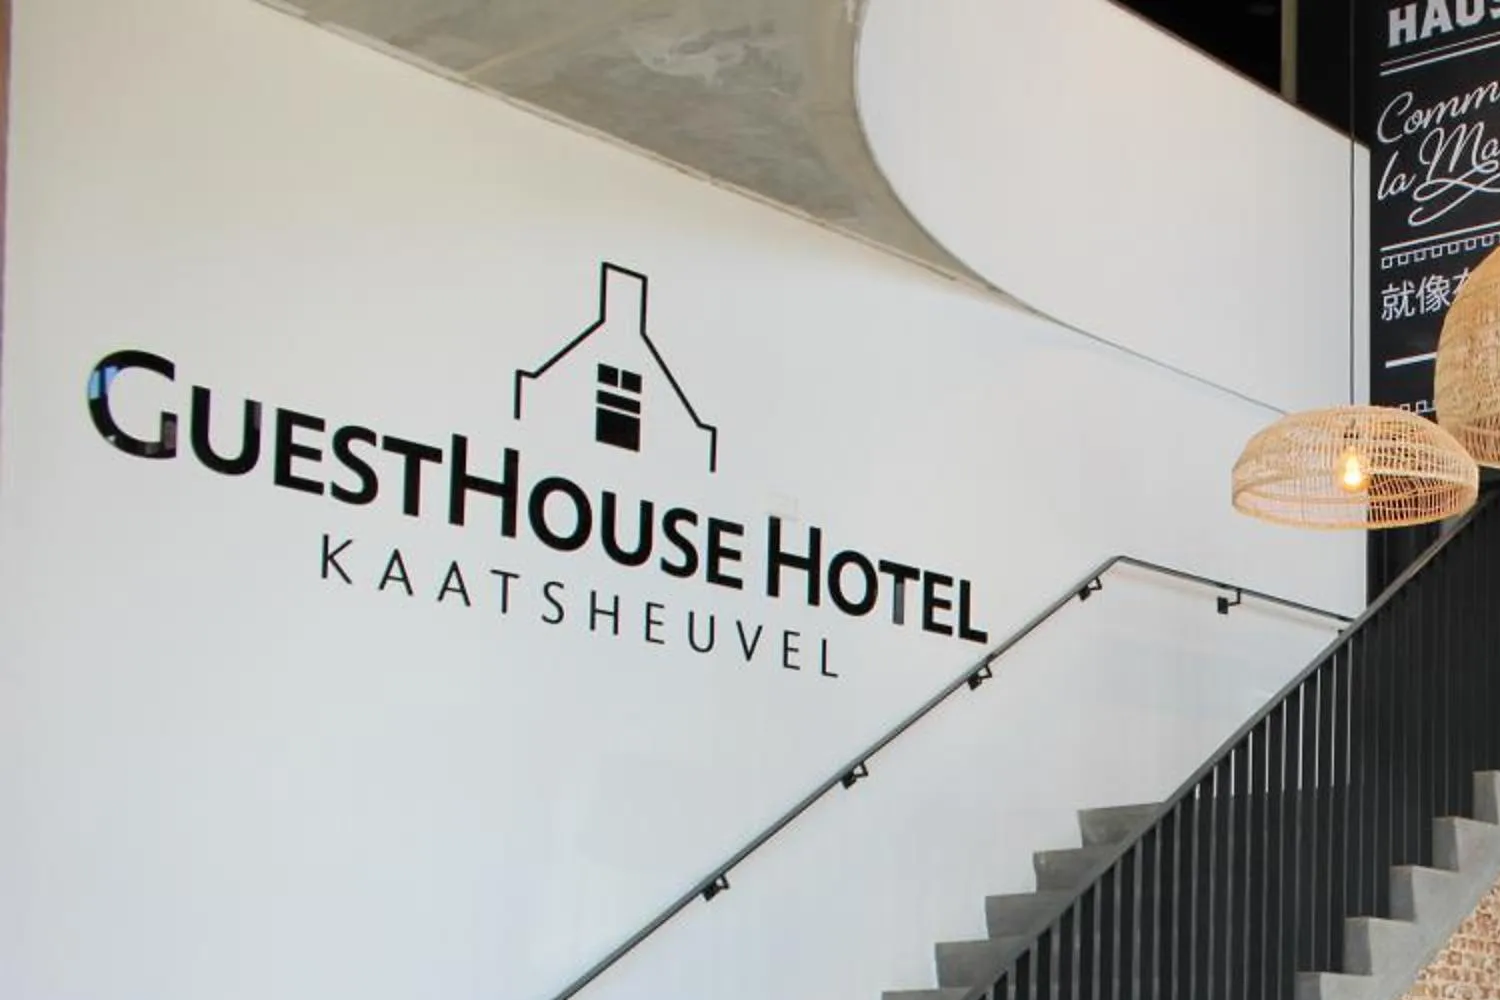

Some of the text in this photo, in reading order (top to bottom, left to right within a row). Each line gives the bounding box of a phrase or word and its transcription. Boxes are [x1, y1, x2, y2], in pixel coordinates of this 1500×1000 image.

[1377, 150, 1417, 202] la
[86, 348, 989, 644] GUESTHOUSE HOTEL
[321, 533, 839, 679] KAATSHEUVEL
